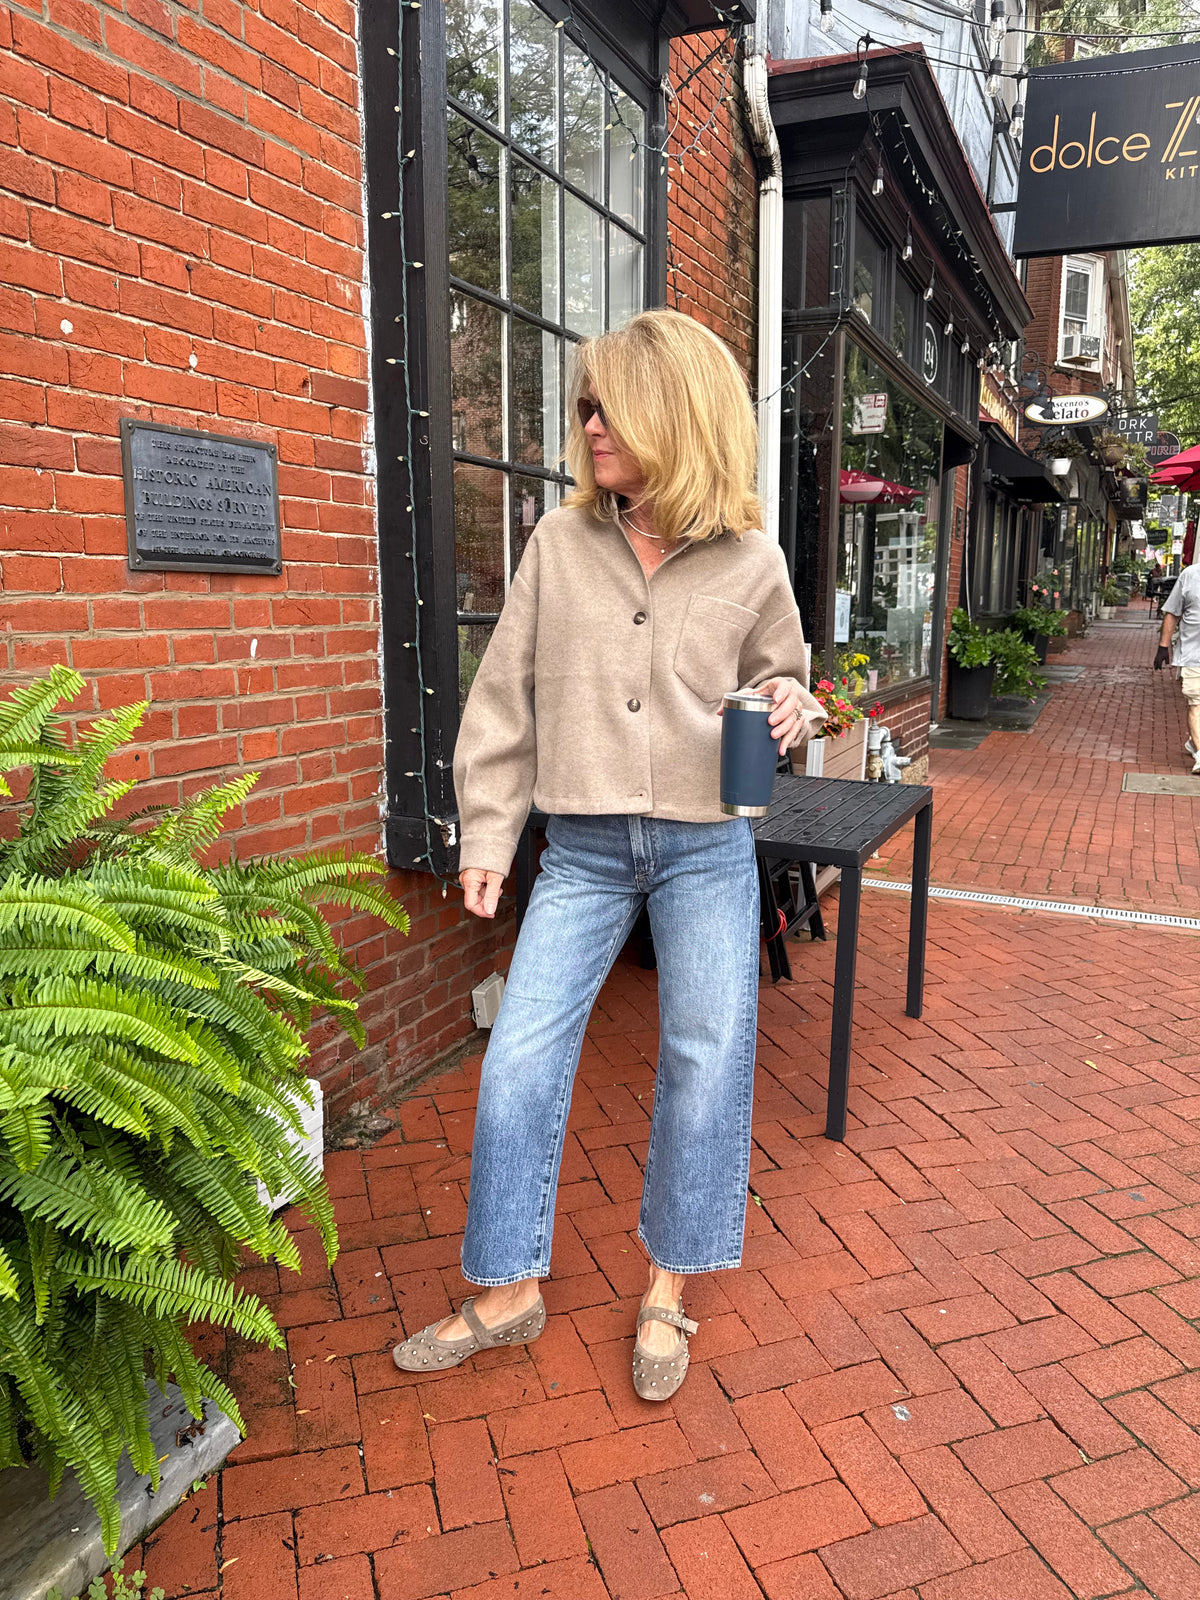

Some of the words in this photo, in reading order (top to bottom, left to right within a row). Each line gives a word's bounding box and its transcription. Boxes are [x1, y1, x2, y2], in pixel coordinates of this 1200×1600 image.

[1029, 111, 1151, 173] dolce
[1165, 165, 1199, 180] KIT
[1053, 407, 1089, 420] elato
[1147, 445, 1180, 456] IRE
[133, 466, 198, 487] HISTORIC
[206, 477, 271, 496] AMERICAN
[142, 490, 212, 511] BUILDINGS
[217, 497, 267, 517] SURVEY
